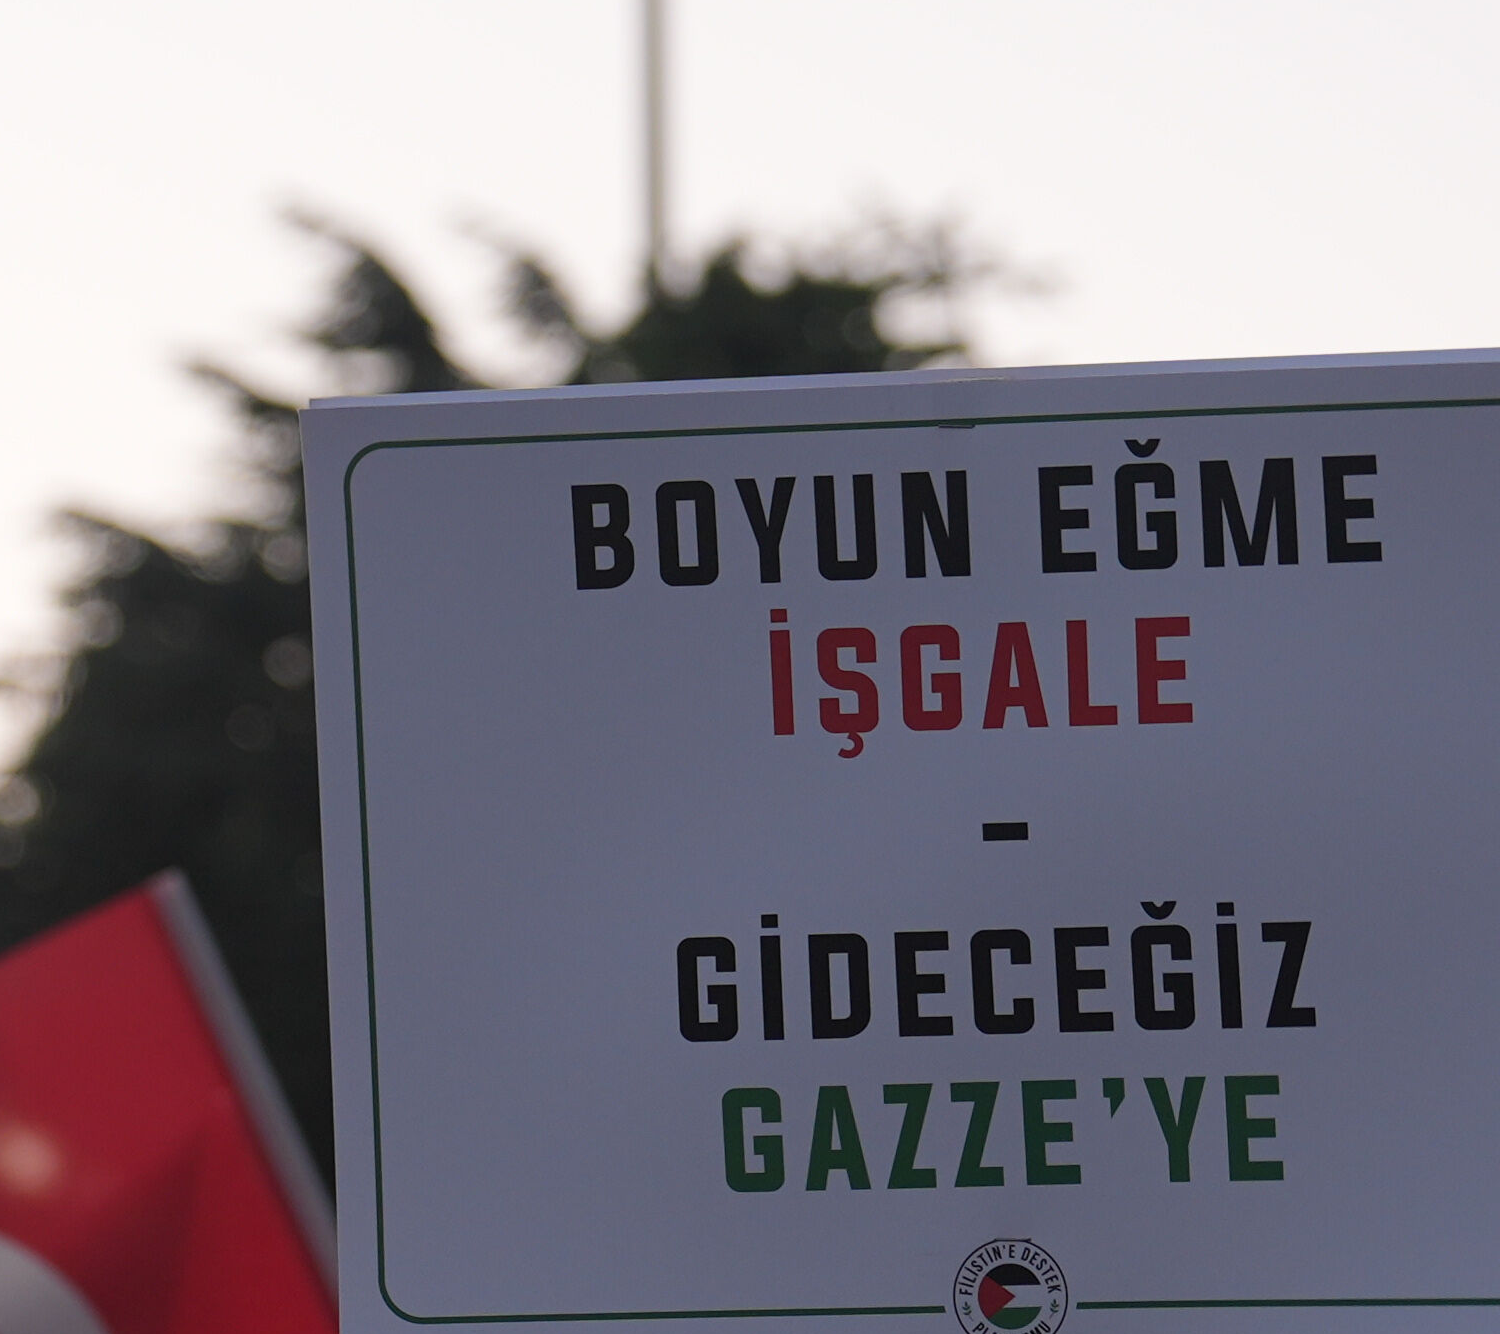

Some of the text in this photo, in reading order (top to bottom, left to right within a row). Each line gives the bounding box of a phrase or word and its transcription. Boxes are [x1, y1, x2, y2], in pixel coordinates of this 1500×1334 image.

[570, 438, 1383, 591] BOYUN EĞME
[769, 608, 1194, 759] İŞGALE
[676, 900, 1317, 1043] GİDECEĞİZ
[721, 1074, 1285, 1193] GAZZE'YE
[959, 1244, 1062, 1296] FİLİSTİN'E DESTEK
